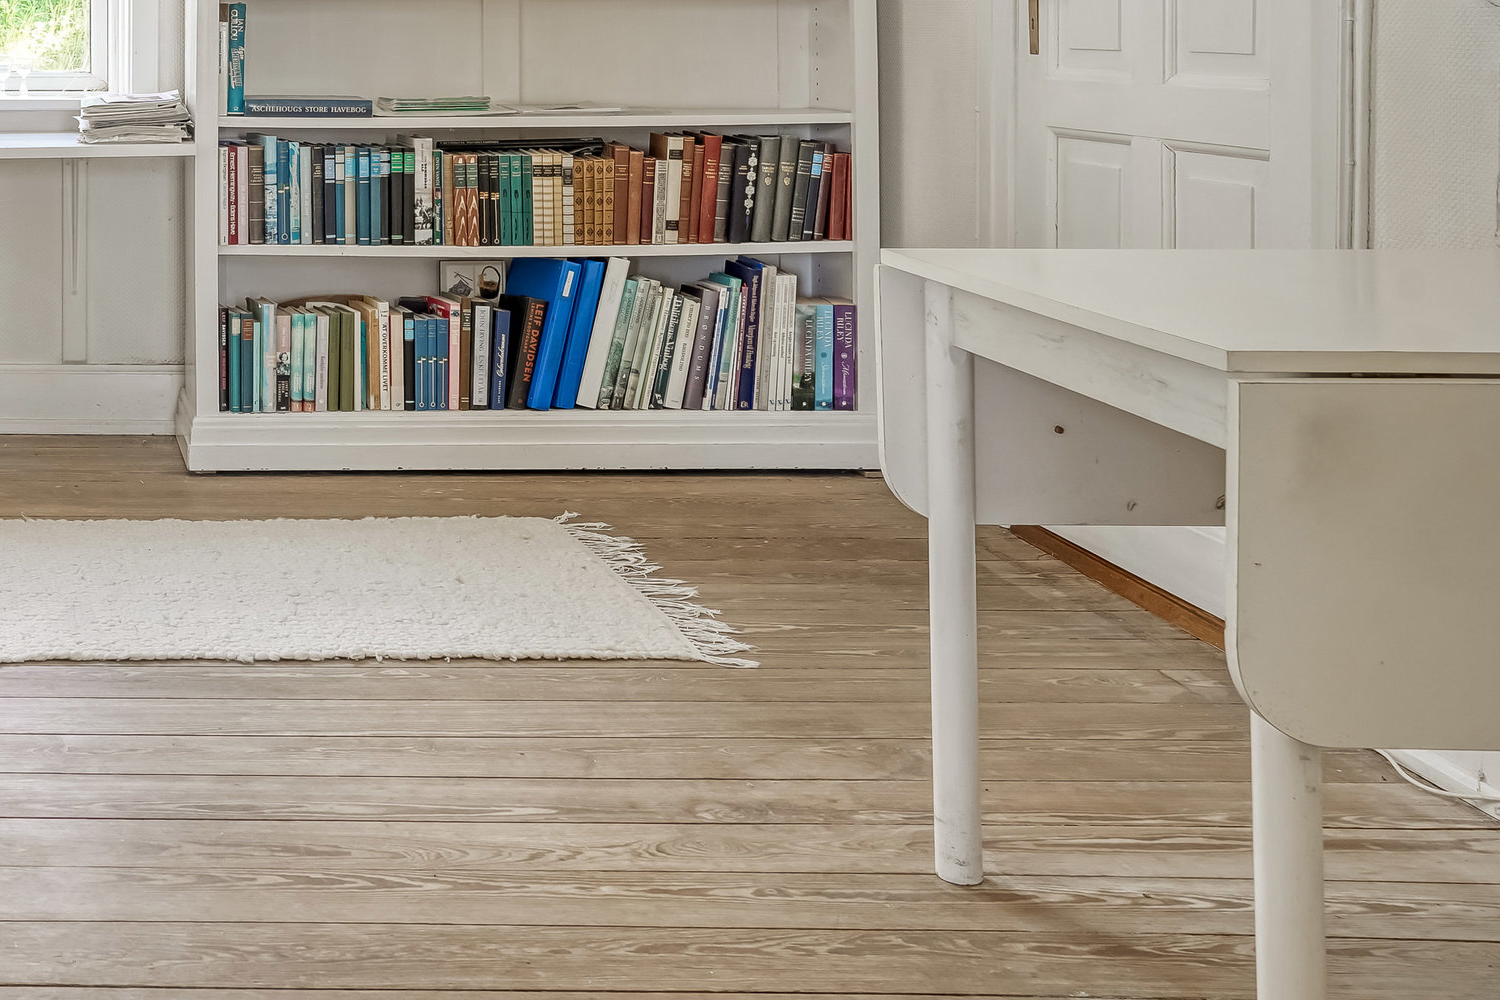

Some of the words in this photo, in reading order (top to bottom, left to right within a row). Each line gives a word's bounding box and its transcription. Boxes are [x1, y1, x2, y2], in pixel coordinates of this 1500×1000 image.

[331, 106, 367, 114] HAVEBOG
[382, 324, 387, 332] AT
[534, 304, 545, 326] LEIF
[666, 299, 682, 340] Politikens
[805, 319, 813, 357] LUCINDA
[824, 310, 832, 348] LUCINDA
[836, 317, 844, 341] RILEY
[523, 329, 540, 382] DAVIDSEN
[659, 340, 674, 371] Vinbog
[804, 358, 812, 382] RILEY
